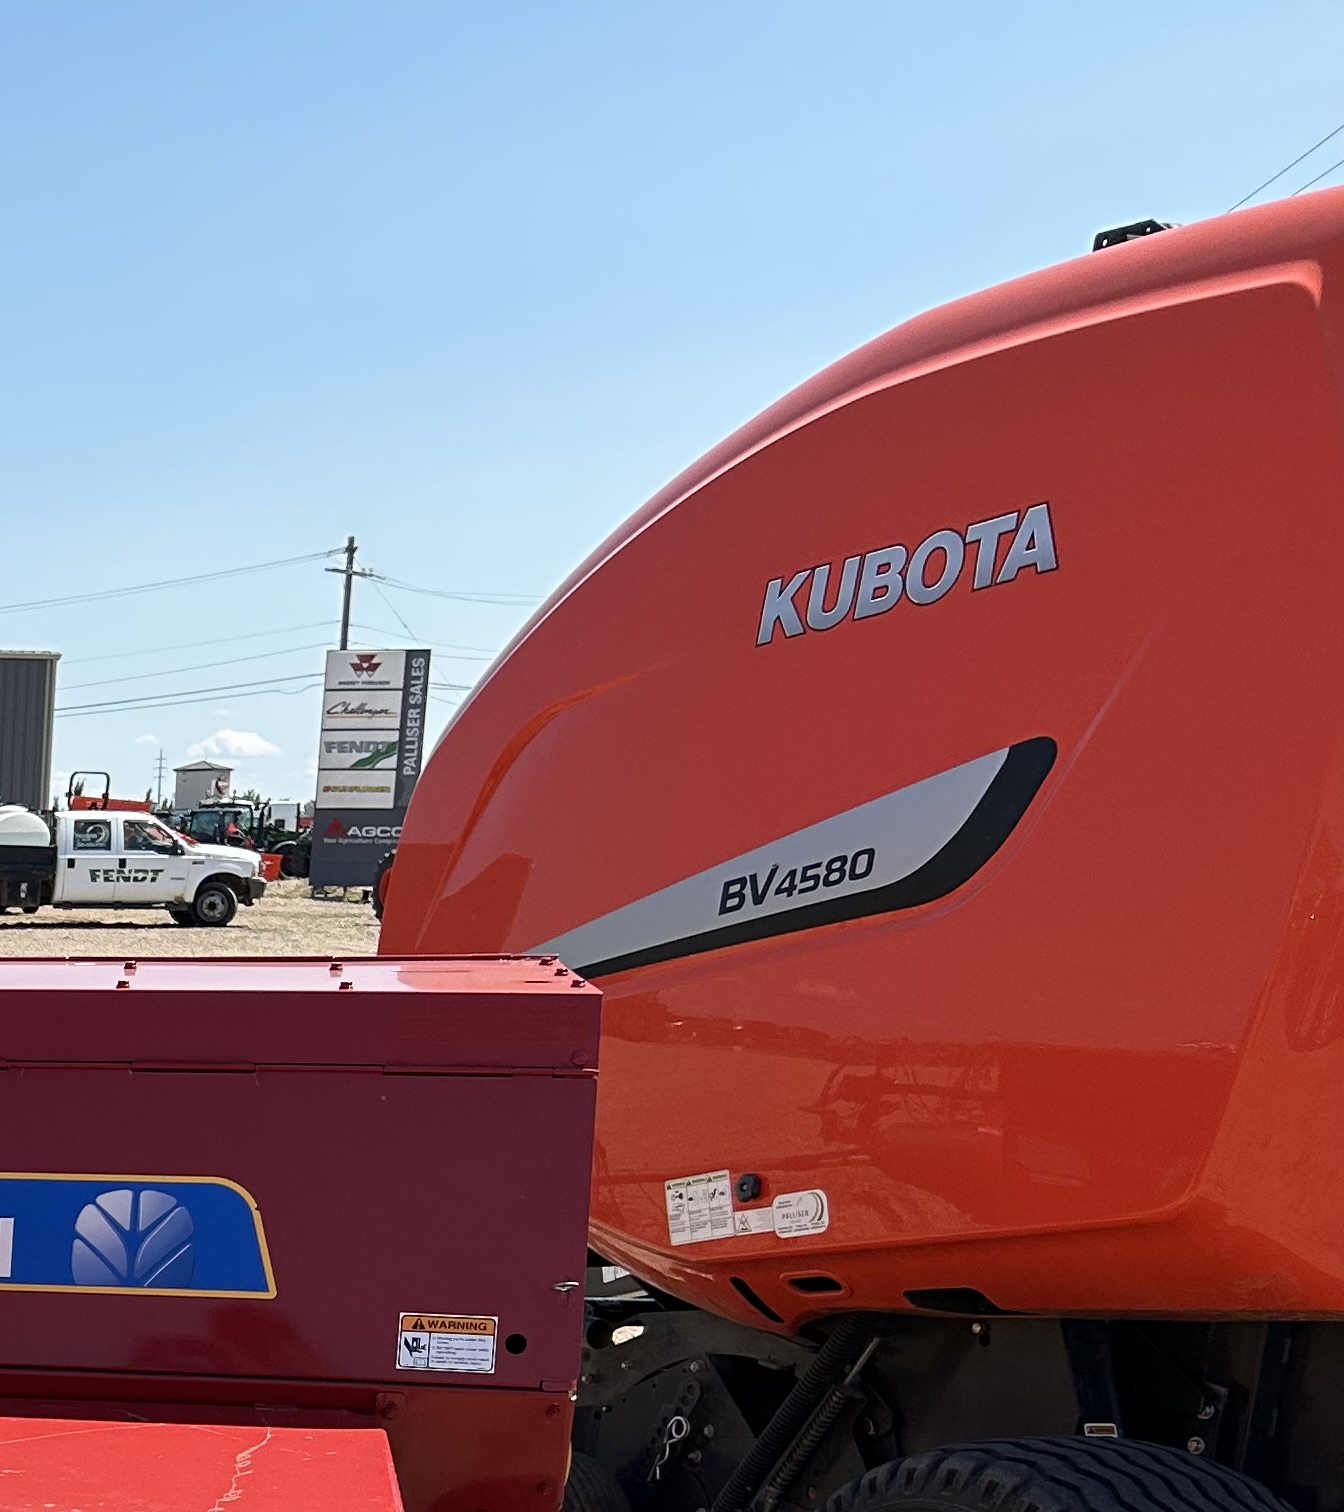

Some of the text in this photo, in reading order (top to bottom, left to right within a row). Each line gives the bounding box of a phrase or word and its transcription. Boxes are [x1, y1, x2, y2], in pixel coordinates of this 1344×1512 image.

[755, 501, 1058, 648] KUBOTA
[403, 658, 425, 775] PALLISER SALES
[324, 741, 395, 754] FENDT
[89, 869, 165, 883] FENDT
[718, 847, 876, 916] BV4580
[427, 1319, 488, 1331] WARNING
